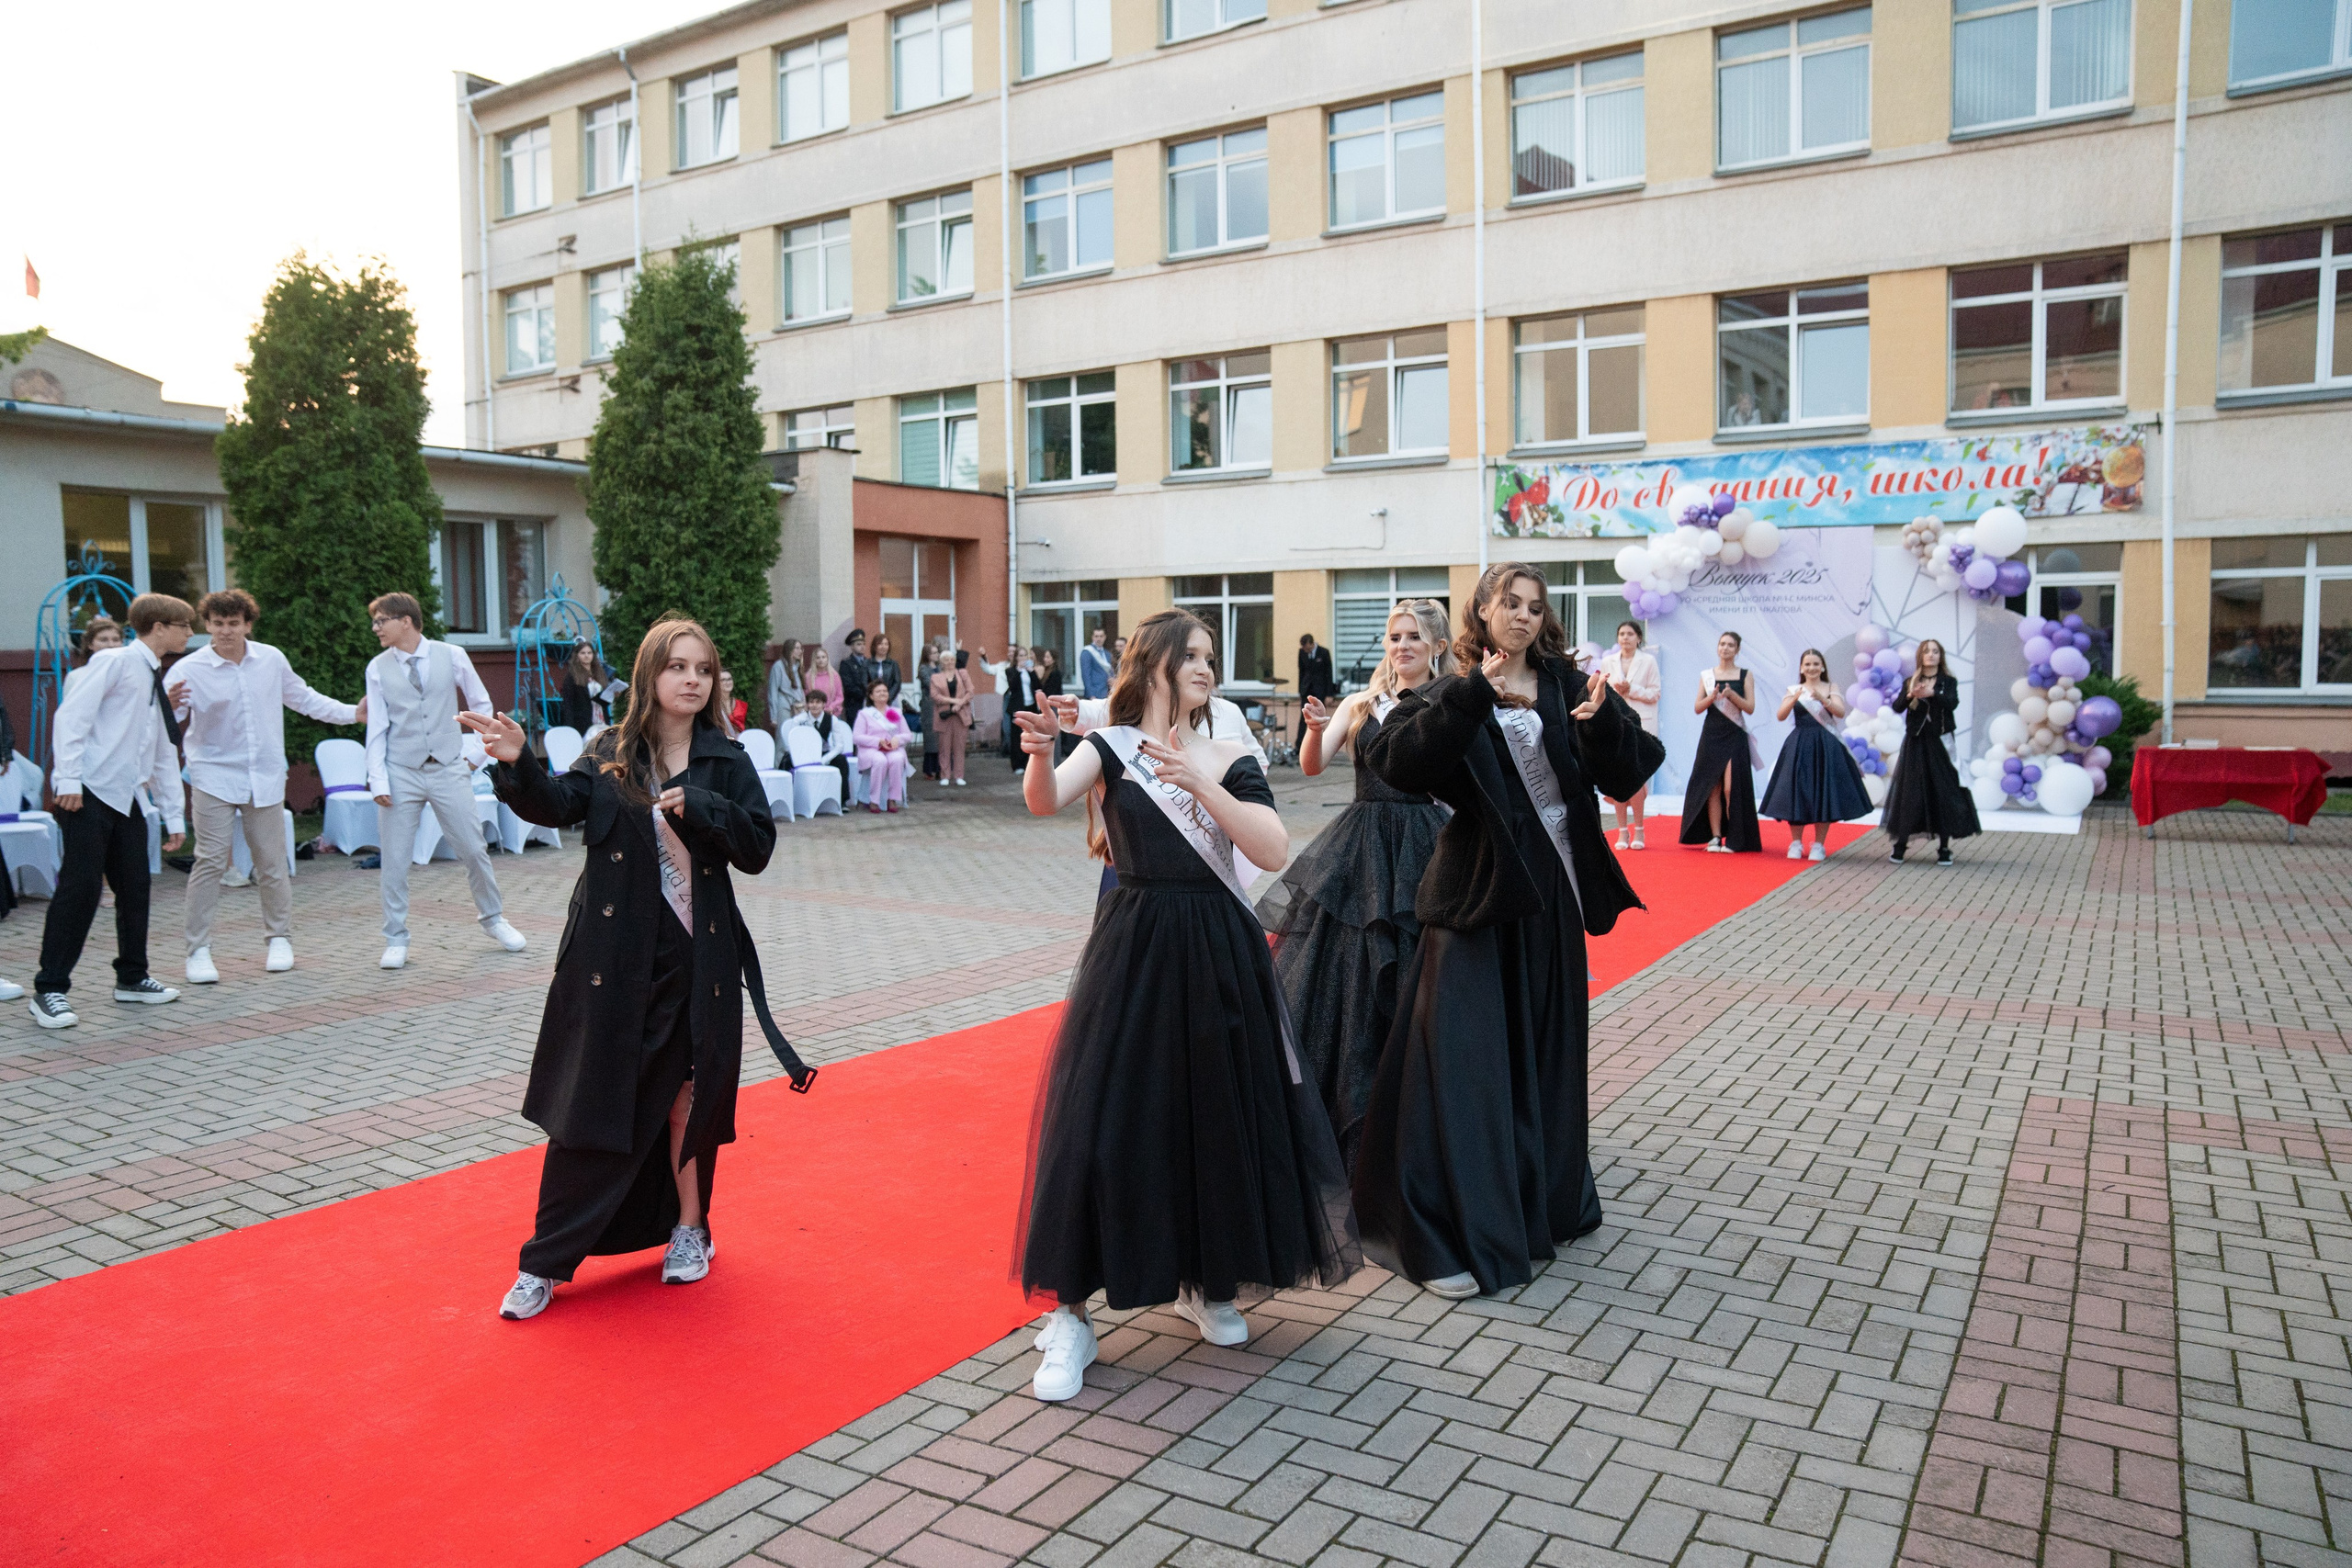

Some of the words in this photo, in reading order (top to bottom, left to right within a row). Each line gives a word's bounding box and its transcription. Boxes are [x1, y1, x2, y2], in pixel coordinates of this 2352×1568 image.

[1563, 475, 1618, 512] До
[1634, 467, 1852, 508] свания,
[1870, 446, 2050, 493] школа!
[1689, 561, 1775, 595] Выпуск
[1777, 567, 1829, 584] 2025
[1738, 594, 1770, 604] ШКОЛА
[1796, 593, 1835, 603] МИНСКА
[1759, 605, 1803, 614] ЧКАЛОВА
